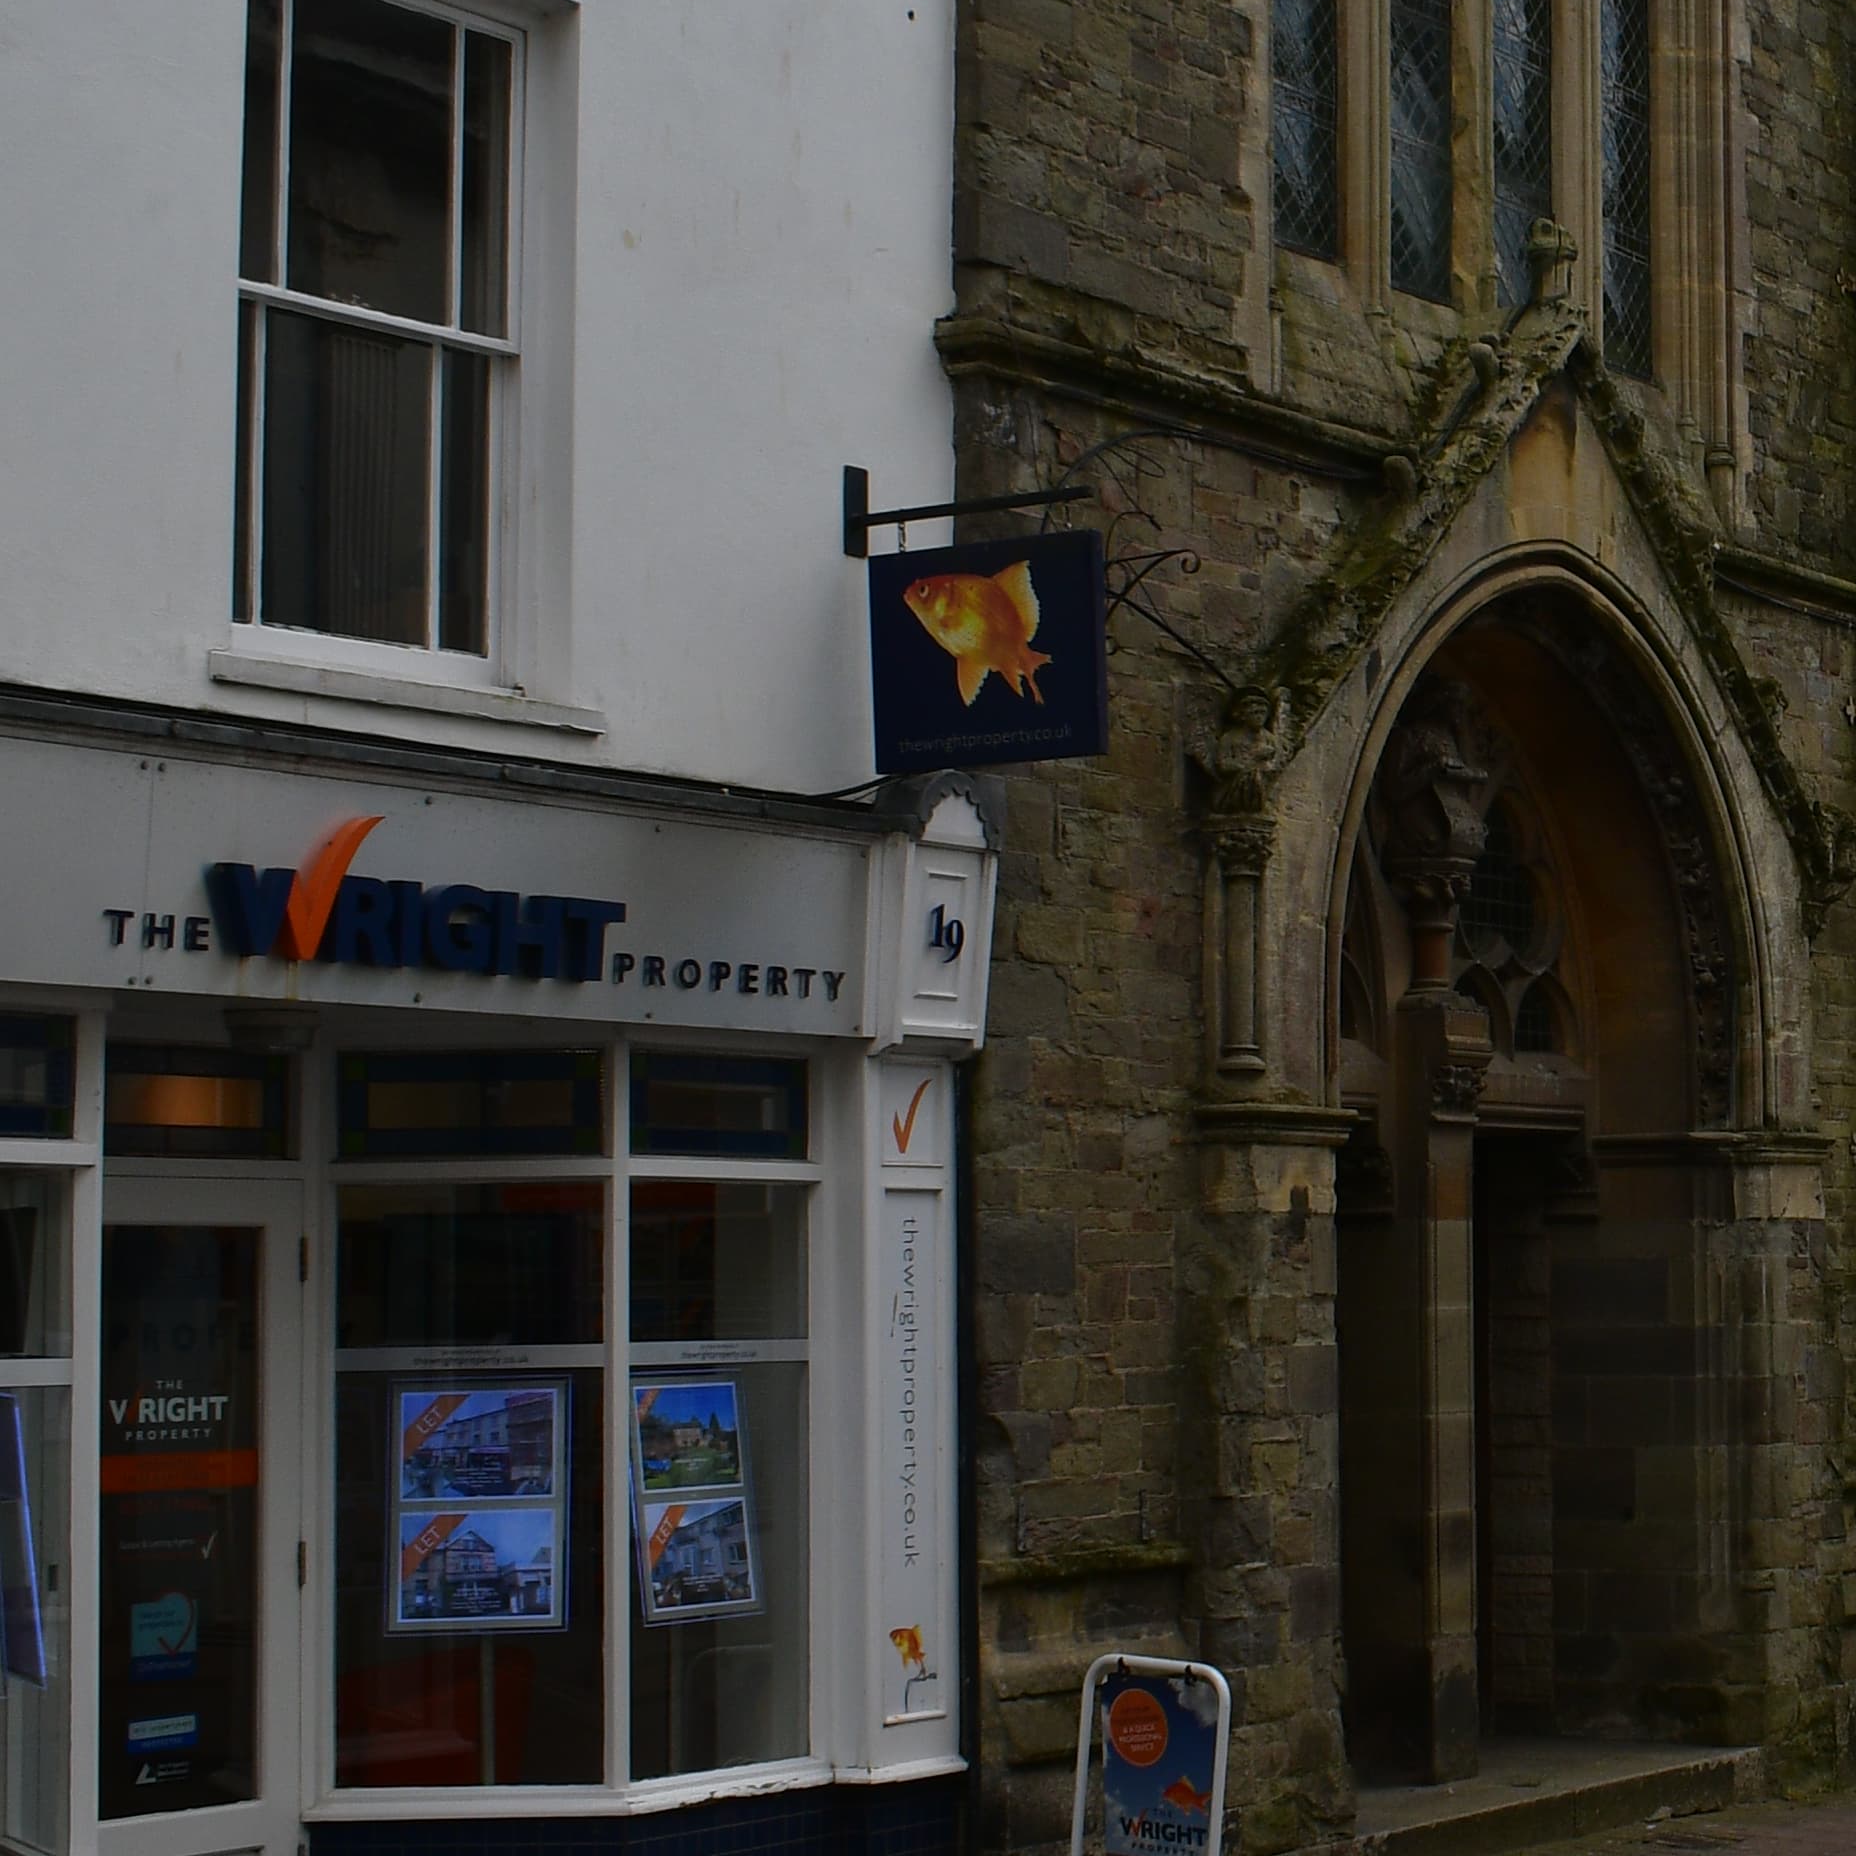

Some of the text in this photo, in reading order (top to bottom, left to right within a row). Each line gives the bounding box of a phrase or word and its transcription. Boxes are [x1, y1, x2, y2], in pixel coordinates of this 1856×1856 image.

[896, 722, 1072, 753] thewrightproperty.co.uk
[103, 816, 846, 1003] THE WRIGHT PROPERTY
[928, 903, 966, 964] 19
[154, 1379, 184, 1391] THE
[898, 1217, 921, 1569] thewrightproperty.co.uk
[124, 1427, 214, 1442] PROPERTY
[415, 1405, 444, 1435] LET
[414, 1524, 442, 1555] LET
[654, 1517, 674, 1546] LET
[1119, 1808, 1208, 1847] WRIGHT
